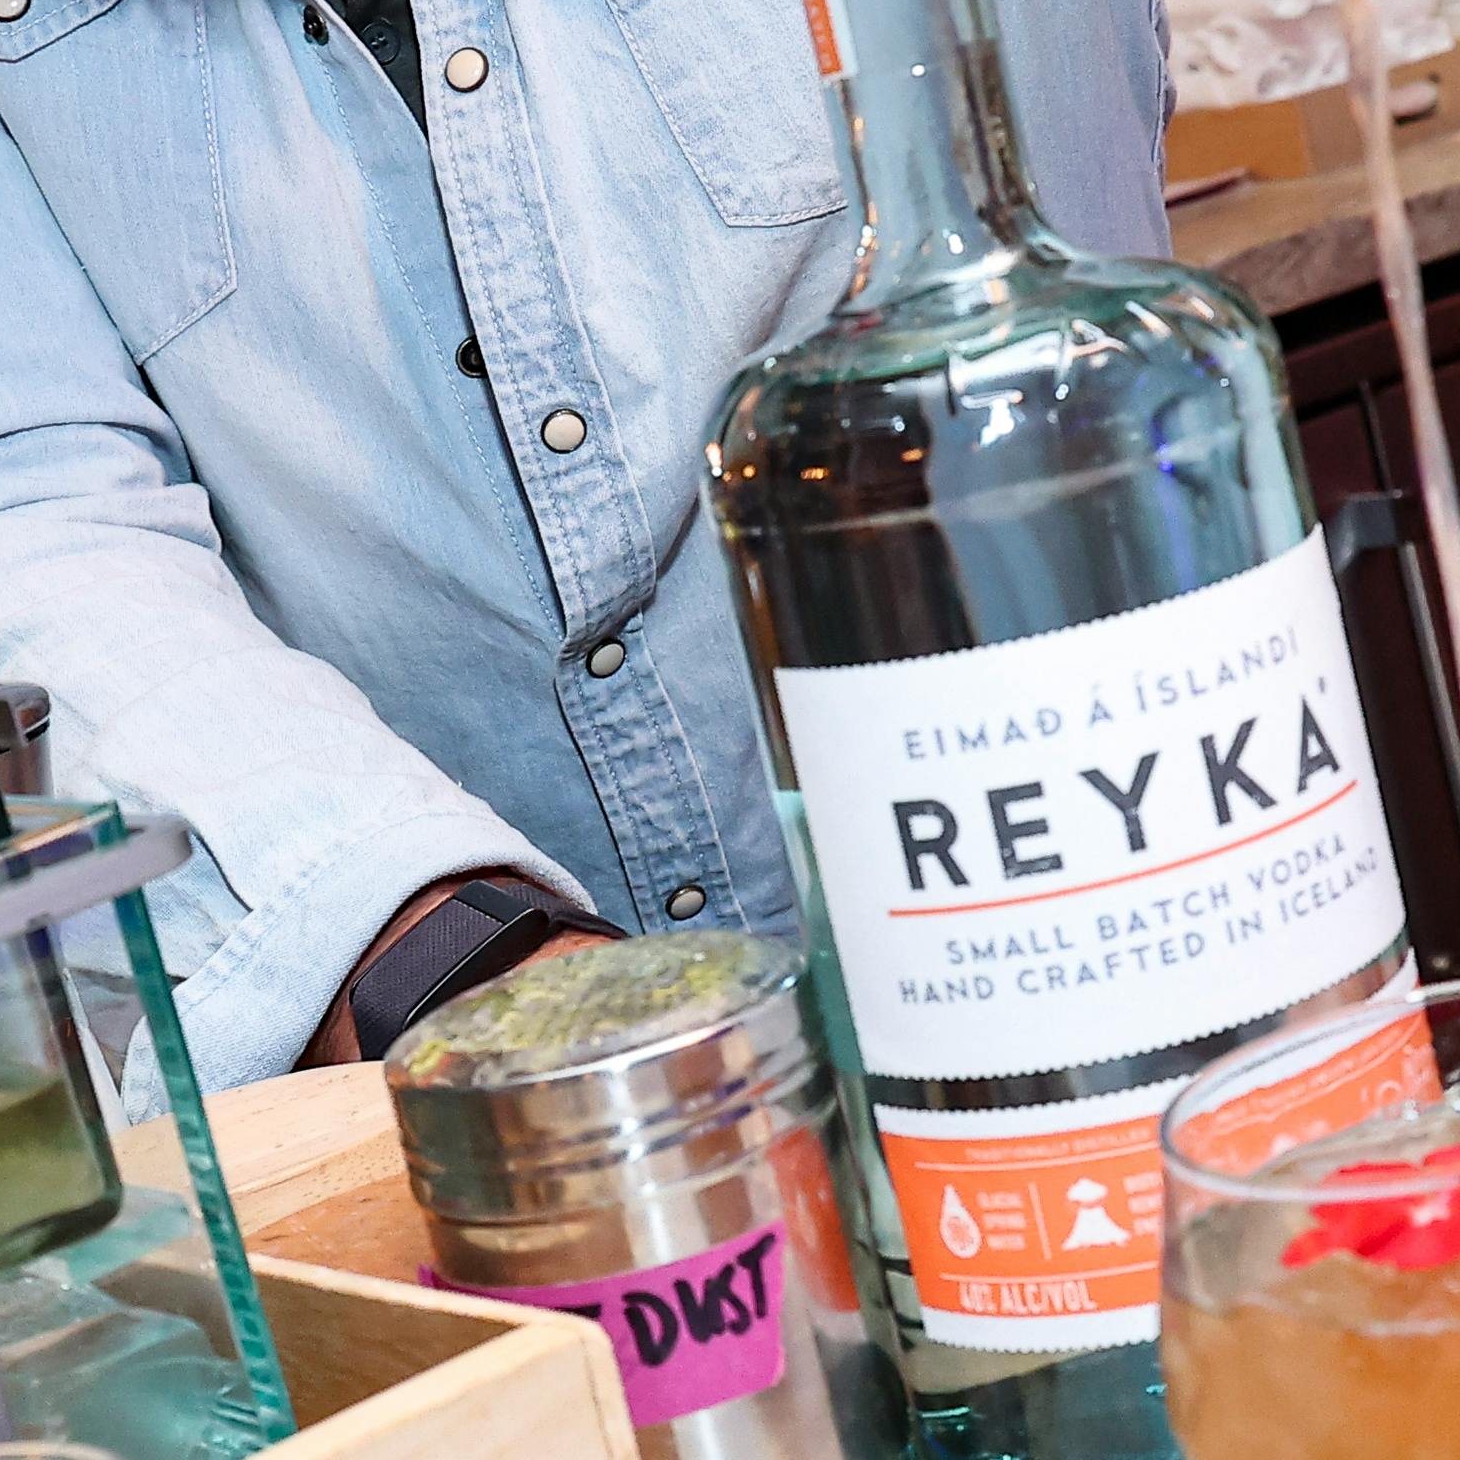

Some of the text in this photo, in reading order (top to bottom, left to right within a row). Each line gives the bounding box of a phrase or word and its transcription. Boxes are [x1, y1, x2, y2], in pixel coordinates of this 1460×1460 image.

[898, 846, 1380, 1004] HAND CRAFTED IN ICELAND
[945, 835, 1346, 966] SMALL BATCH VODKA
[623, 1232, 777, 1367] DUST
